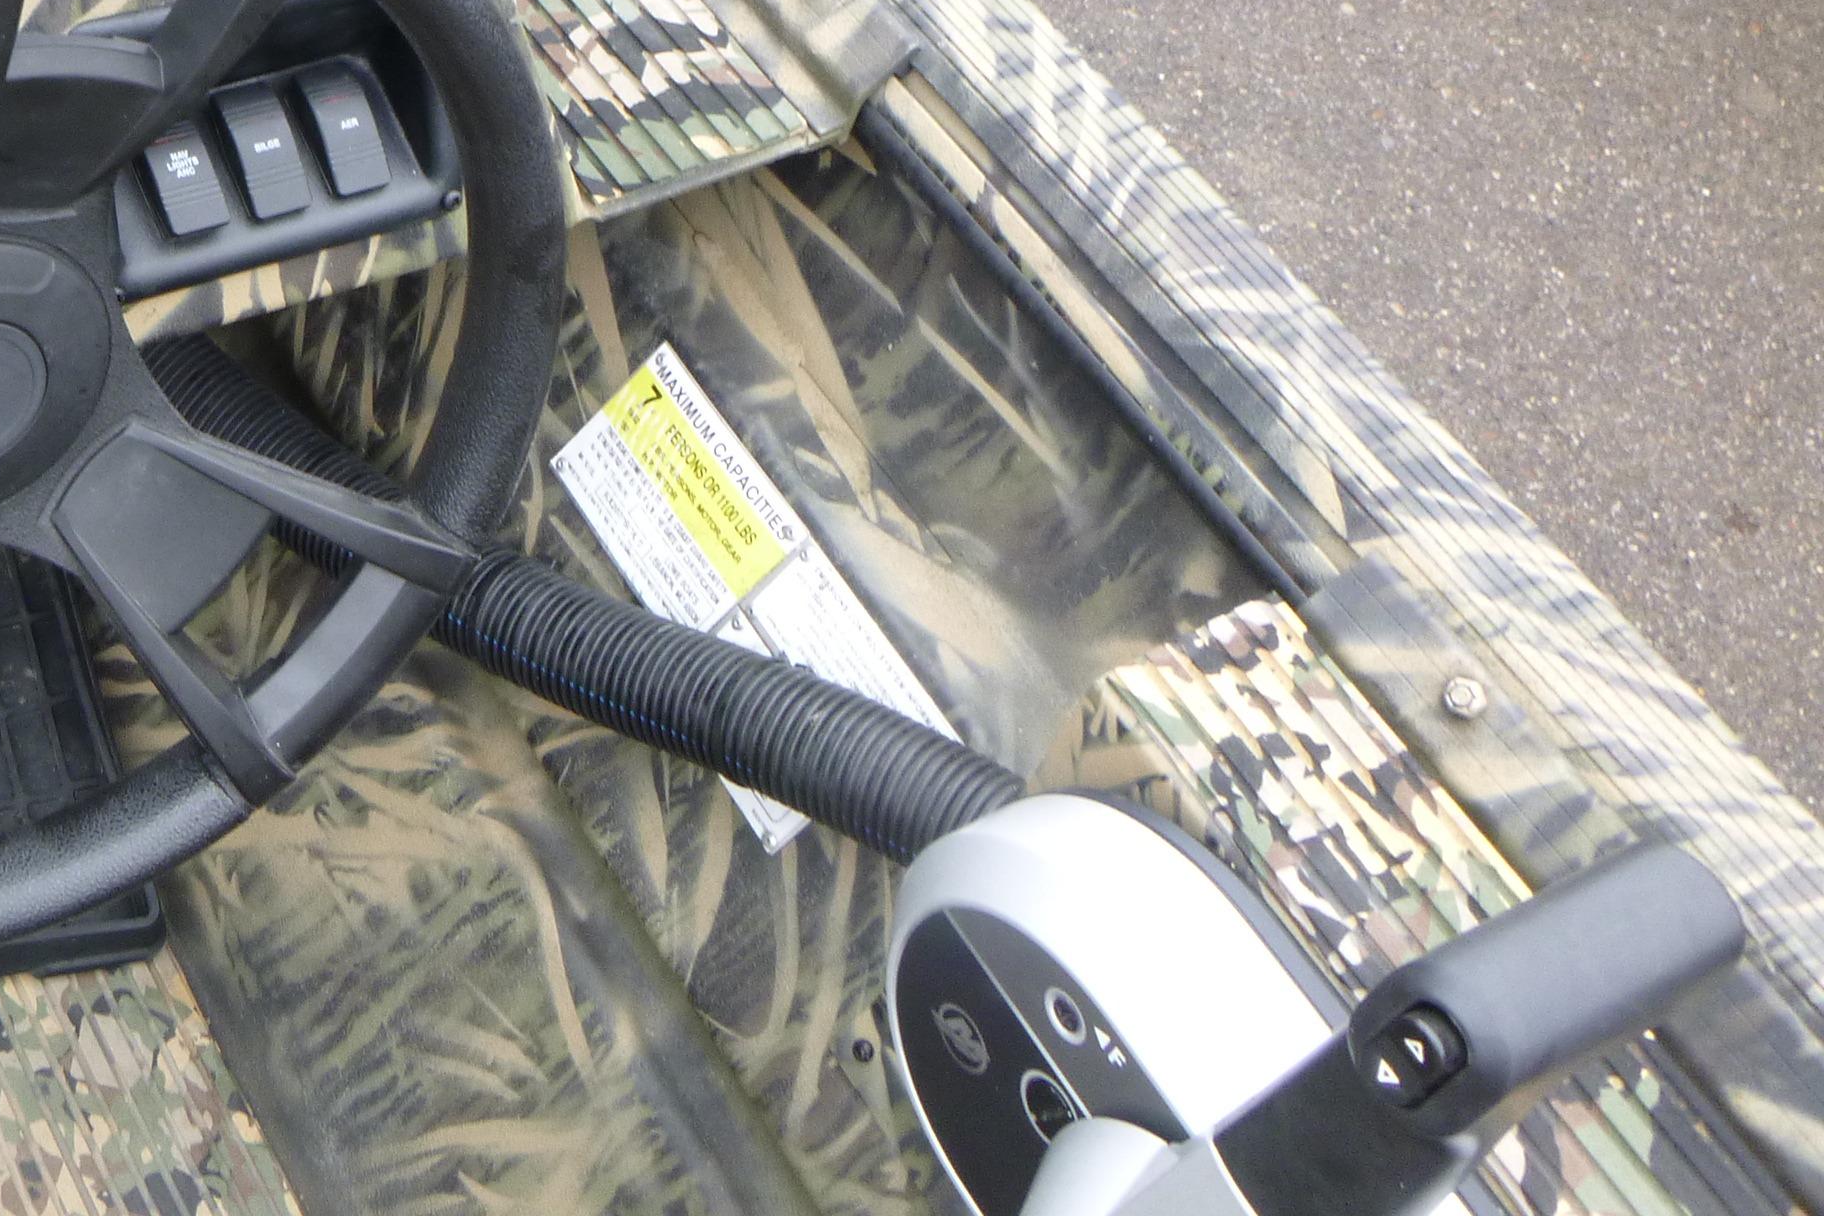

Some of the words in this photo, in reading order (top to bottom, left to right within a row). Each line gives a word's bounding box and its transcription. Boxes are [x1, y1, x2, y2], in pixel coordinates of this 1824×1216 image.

[166, 156, 199, 172] LIGHTS
[635, 383, 664, 411] 7
[701, 475, 723, 498] OR
[714, 493, 741, 523] 1100
[733, 518, 758, 546] LBS
[654, 363, 718, 443] MAXIMUM
[712, 440, 793, 543] CAPACITIES
[719, 536, 743, 564] GEAR
